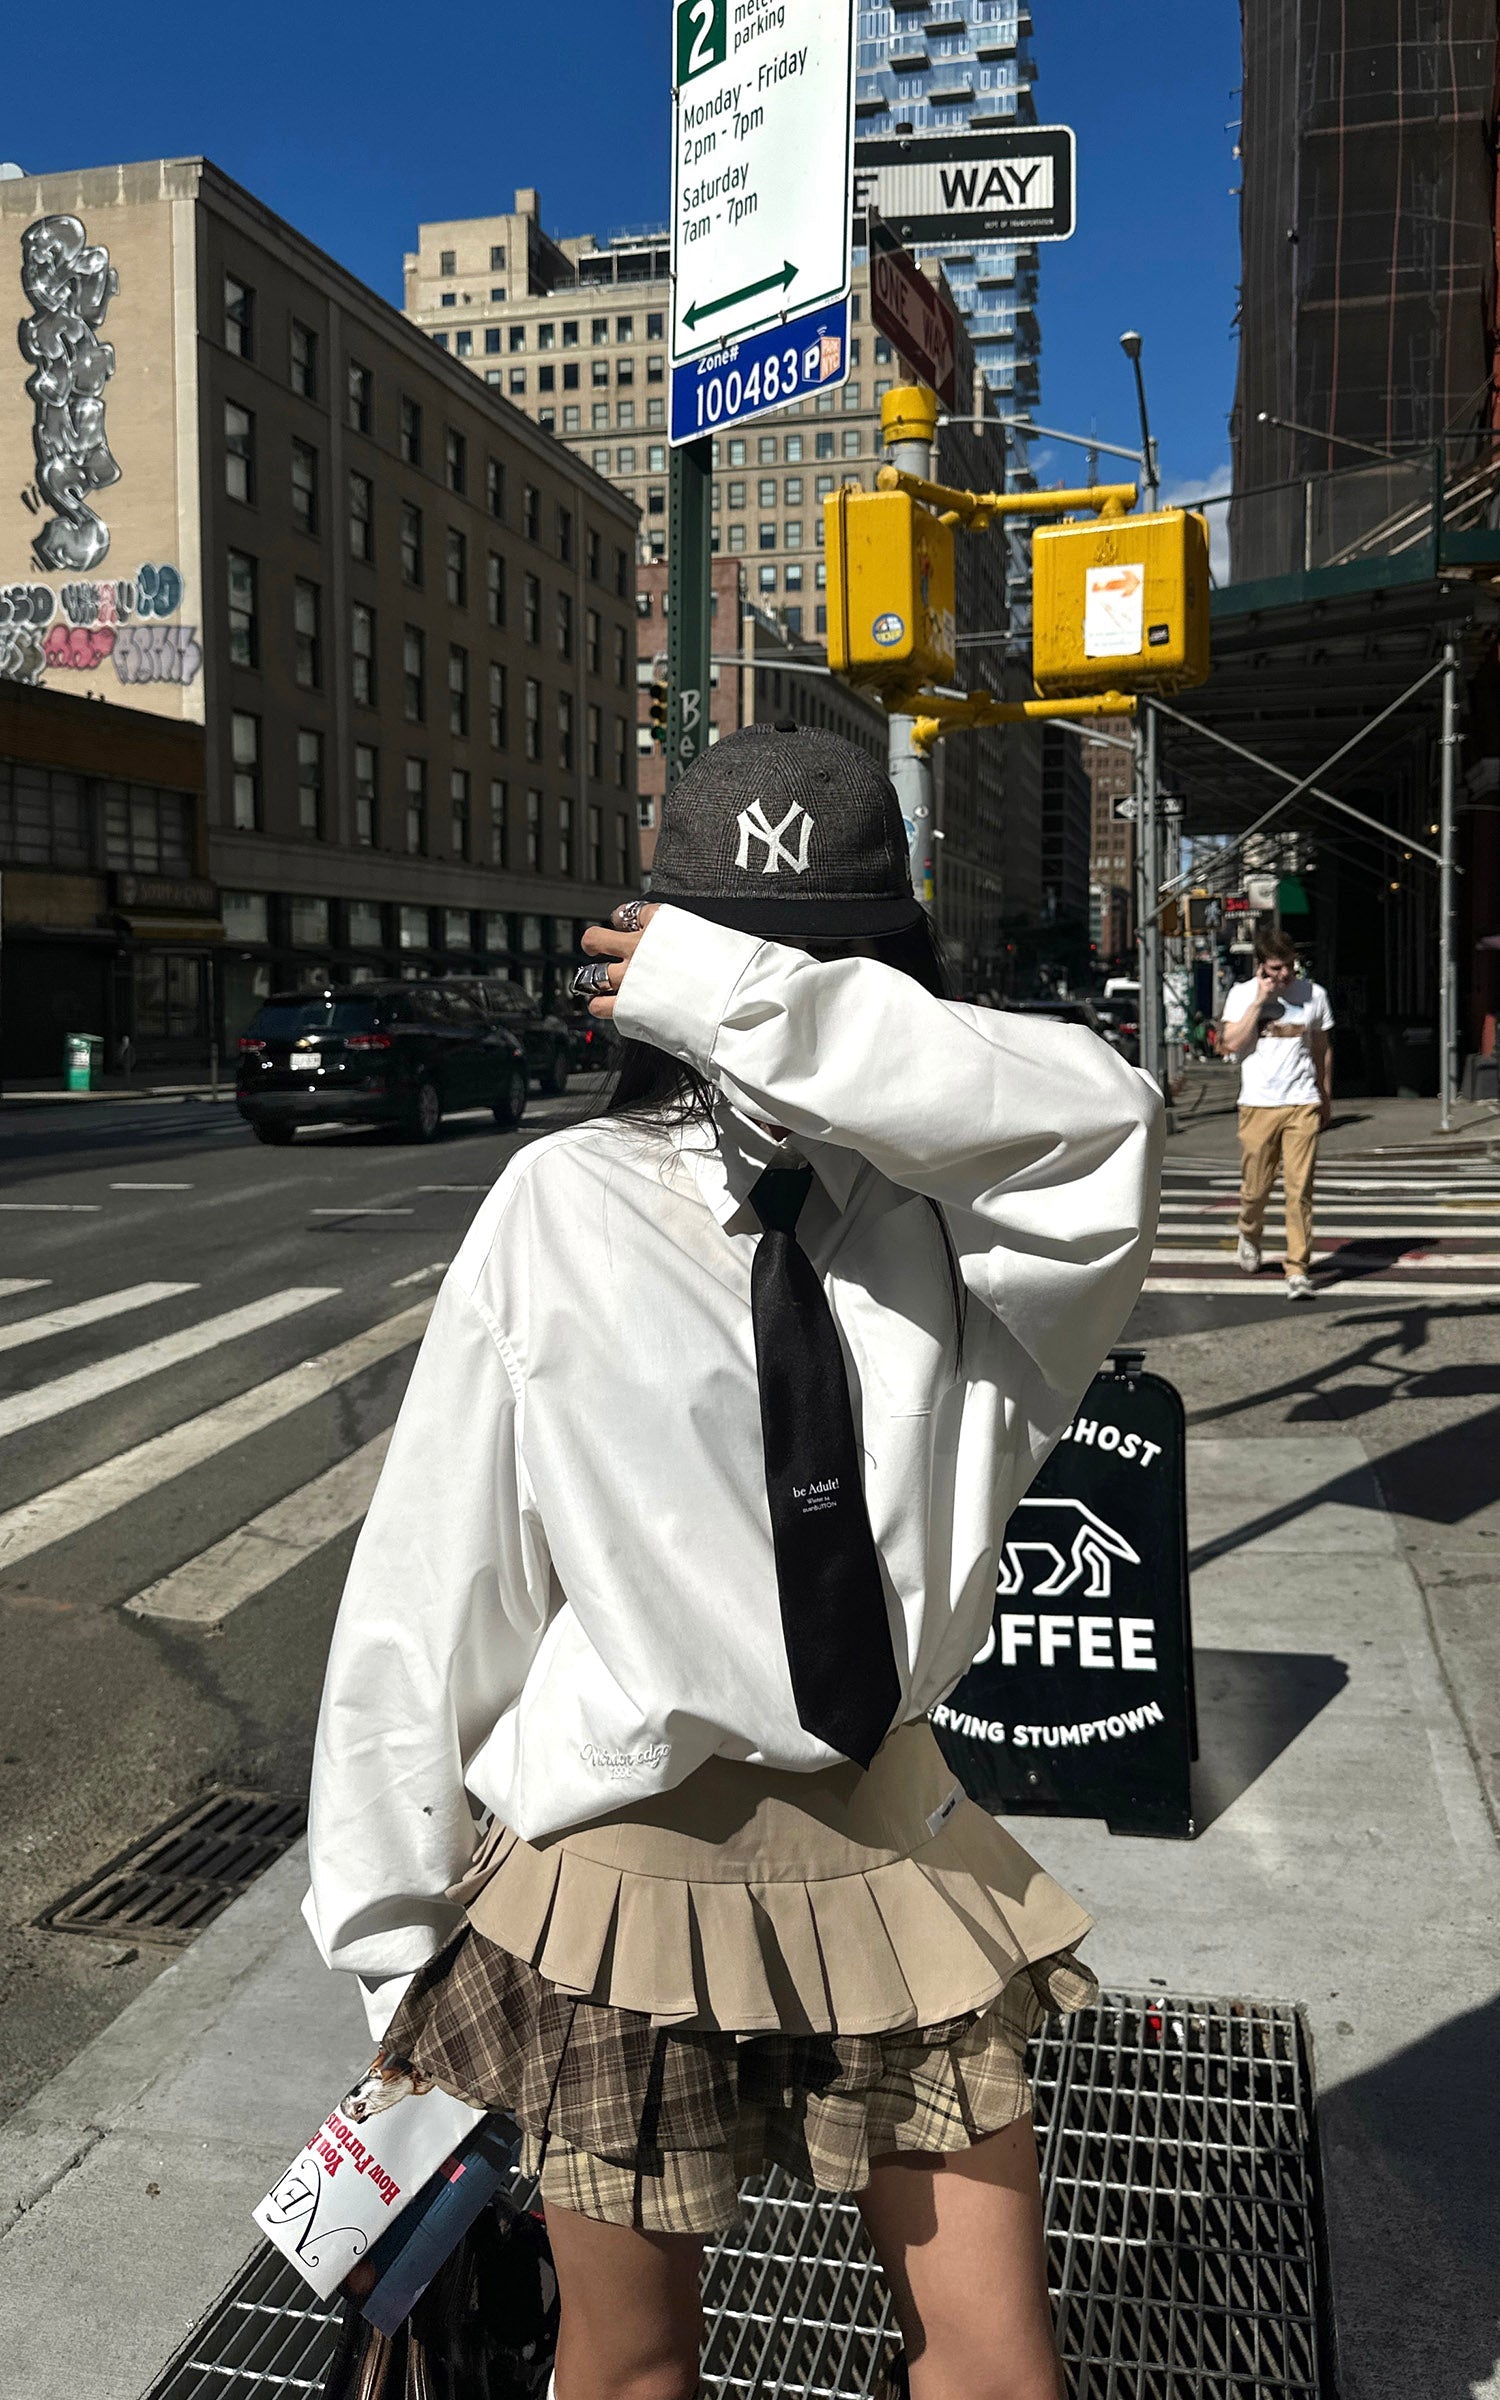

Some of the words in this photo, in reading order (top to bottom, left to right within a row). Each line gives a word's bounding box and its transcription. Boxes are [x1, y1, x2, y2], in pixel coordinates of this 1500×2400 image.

[688, 0, 715, 74] 2
[735, 5, 785, 54] parking
[684, 84, 741, 132] Monday
[758, 46, 808, 92] Friday
[684, 132, 716, 165] 2pm
[732, 106, 764, 141] 7pm
[683, 162, 749, 212] Saturday
[940, 164, 1042, 208] WAY
[682, 216, 711, 245] 7am
[727, 192, 758, 226] 7pm
[878, 257, 908, 326] ONE
[696, 345, 740, 375] Zone#
[805, 346, 820, 379] P
[696, 348, 798, 426] 100483
[735, 798, 815, 875] NY
[1061, 1417, 1162, 1467] HOST
[792, 1487, 807, 1498] be
[808, 1477, 840, 1495] Adult!
[972, 1614, 1158, 1672] FFEE
[927, 1704, 1006, 1742] RVING
[1012, 1701, 1165, 1748] STUMPTOWN
[316, 2138, 344, 2178] You
[325, 2112, 375, 2175] Furious
[367, 2164, 401, 2207] How
